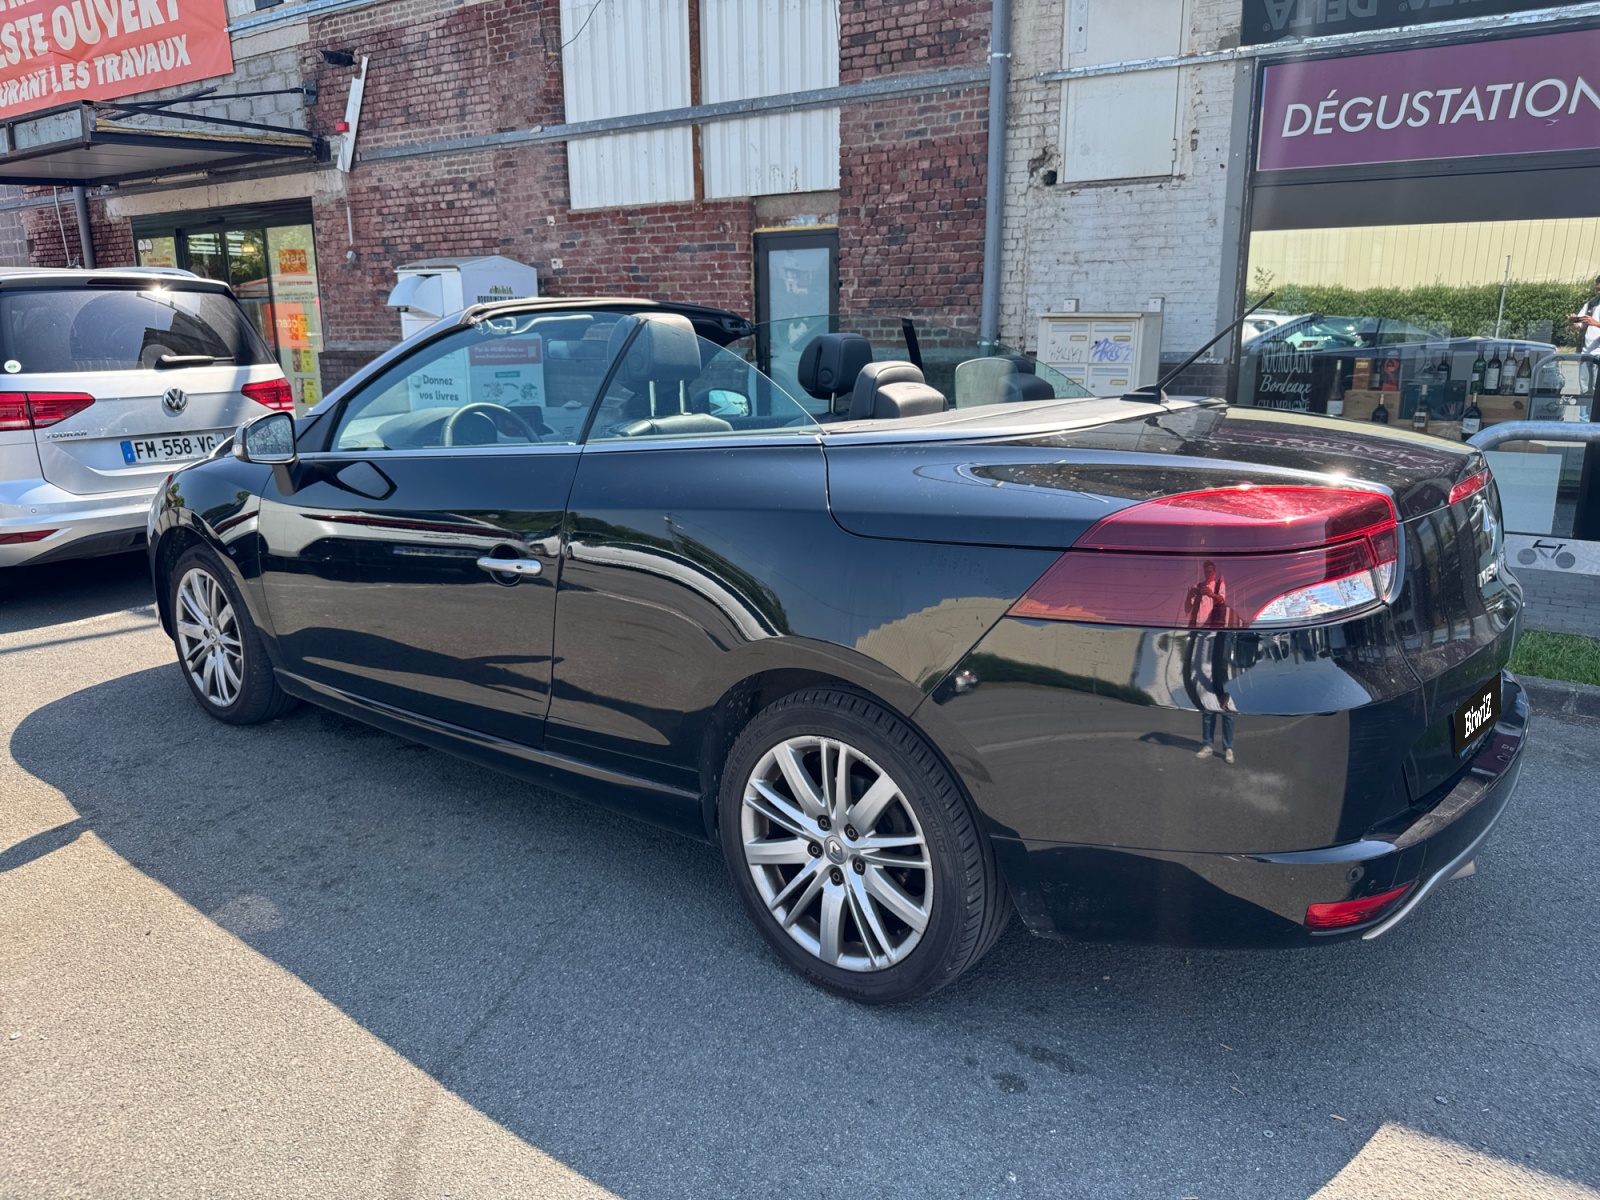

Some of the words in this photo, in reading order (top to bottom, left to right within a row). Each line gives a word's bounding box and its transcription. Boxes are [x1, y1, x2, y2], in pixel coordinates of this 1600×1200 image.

[50, 60, 91, 93] LES
[93, 34, 192, 85] TRAVAUX
[422, 374, 453, 386] Donnez
[1259, 368, 1312, 402] Bordeaux
[419, 392, 433, 400] vos
[435, 390, 459, 401] livres
[45, 430, 88, 439] TOURAN
[134, 435, 216, 460] FM-558-VG
